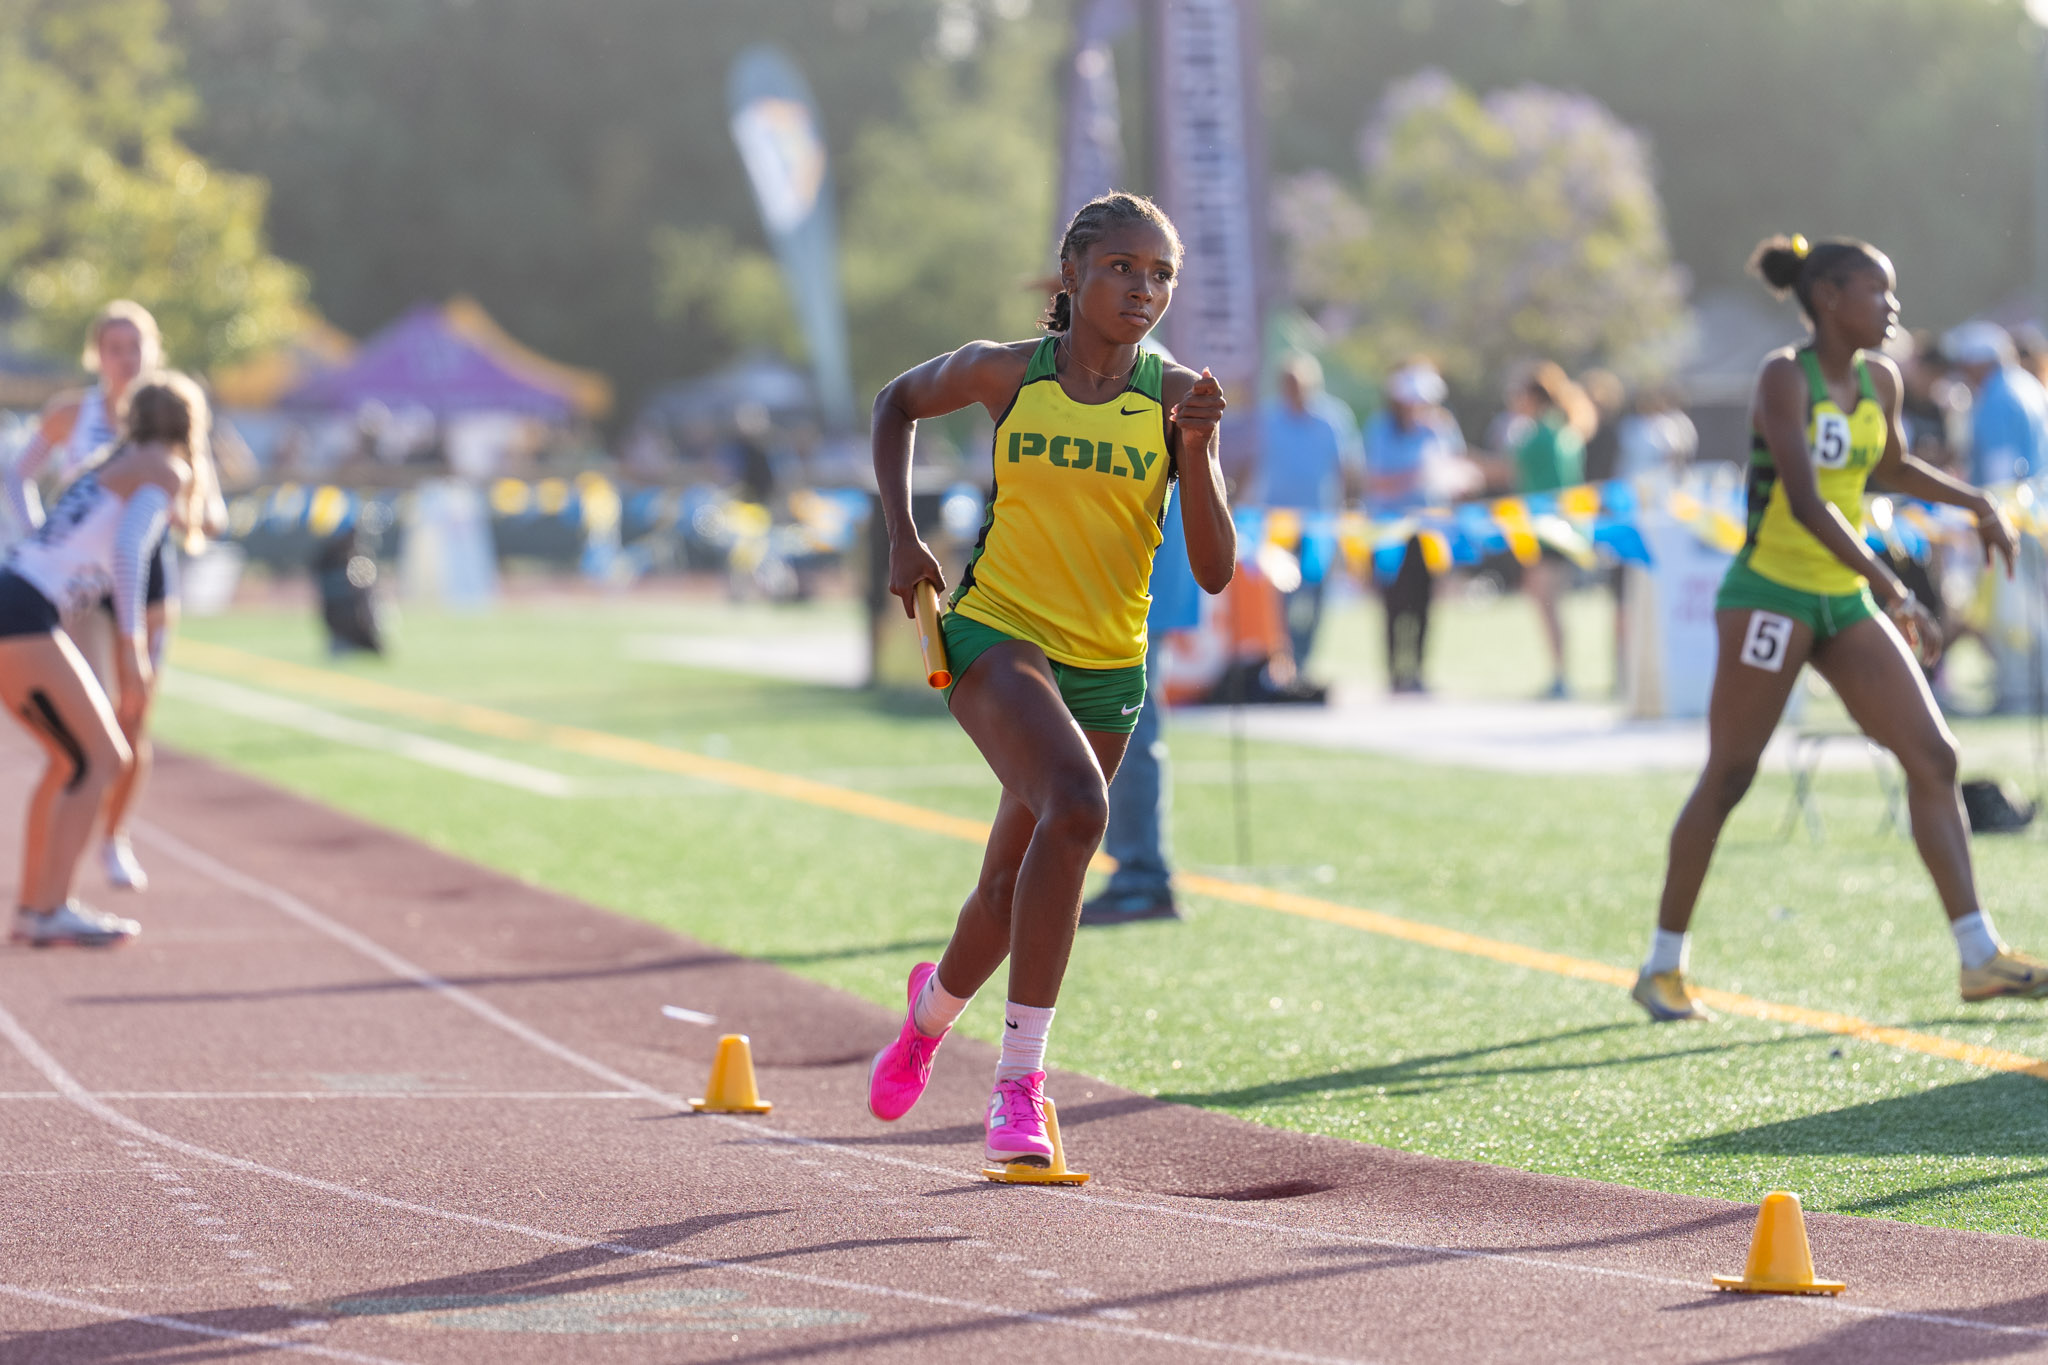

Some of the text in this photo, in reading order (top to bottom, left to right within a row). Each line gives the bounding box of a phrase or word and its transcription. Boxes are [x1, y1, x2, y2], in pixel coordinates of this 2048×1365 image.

[1008, 432, 1158, 482] POLY
[1823, 421, 1843, 461] 5
[1752, 620, 1780, 661] 5
